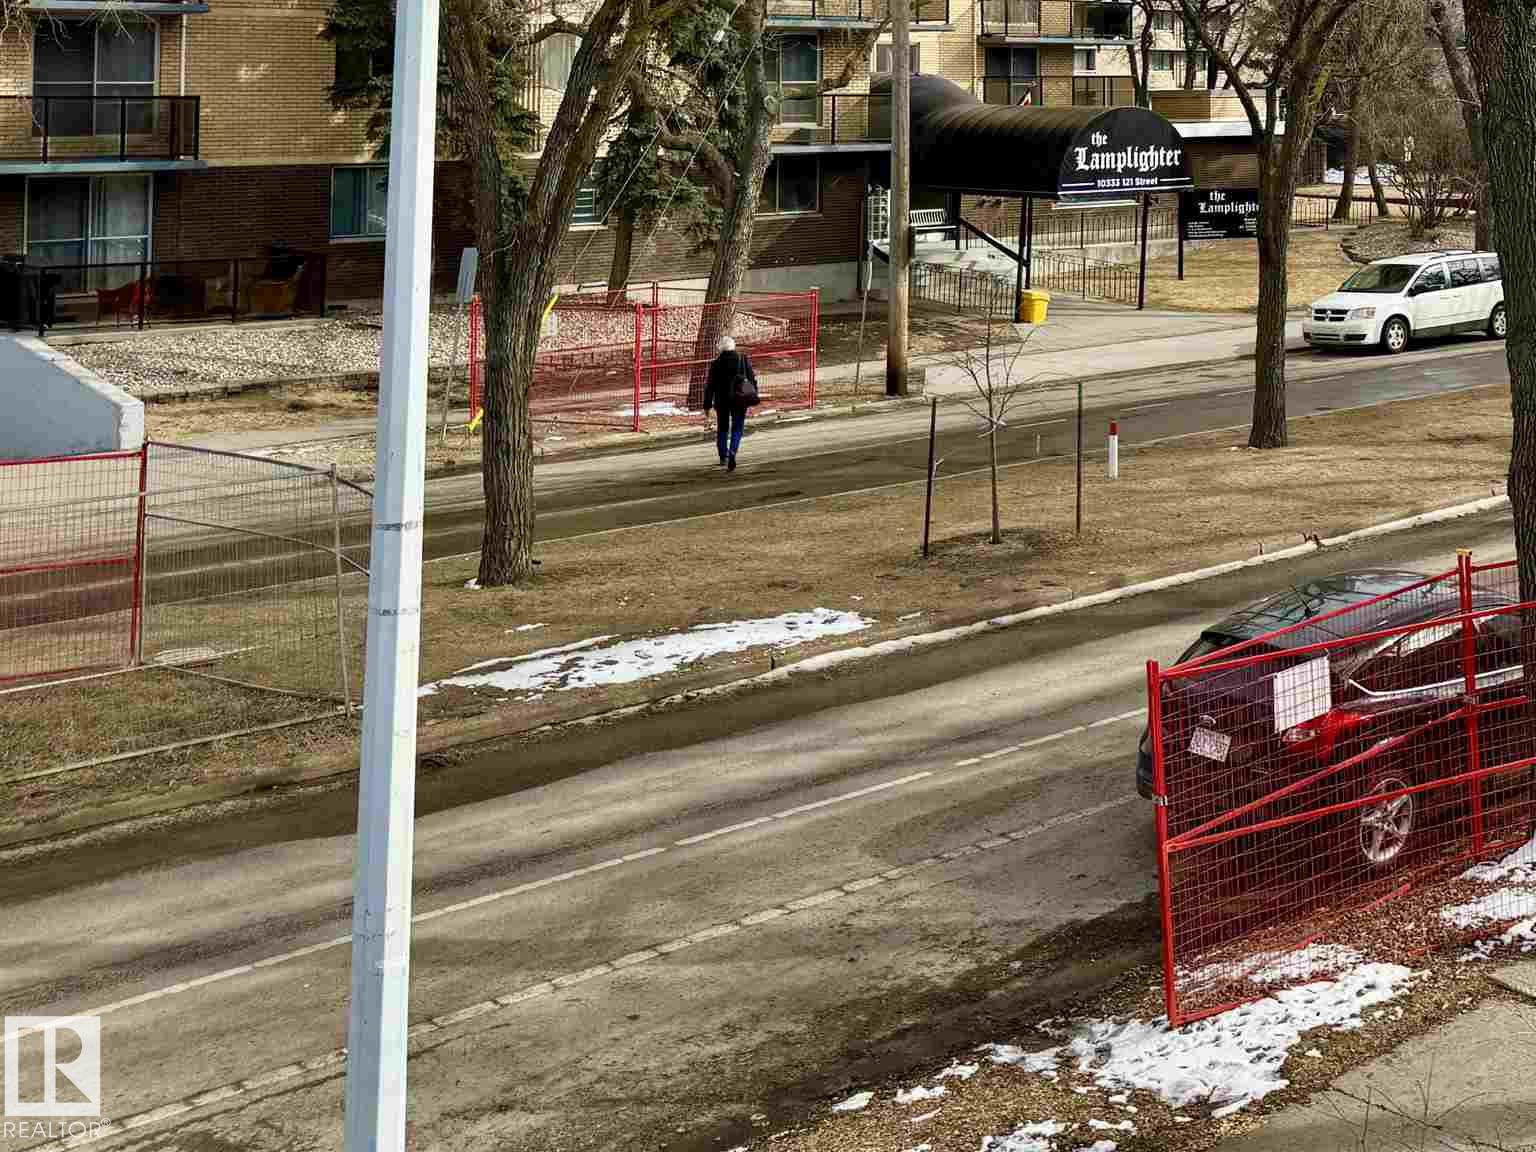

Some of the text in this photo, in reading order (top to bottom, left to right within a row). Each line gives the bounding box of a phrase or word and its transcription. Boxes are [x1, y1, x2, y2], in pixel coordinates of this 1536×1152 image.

[1091, 131, 1108, 147] the
[1074, 145, 1182, 173] Lamplighter
[1122, 177, 1134, 186] 121
[1135, 176, 1158, 186] Street
[1209, 191, 1226, 202] the
